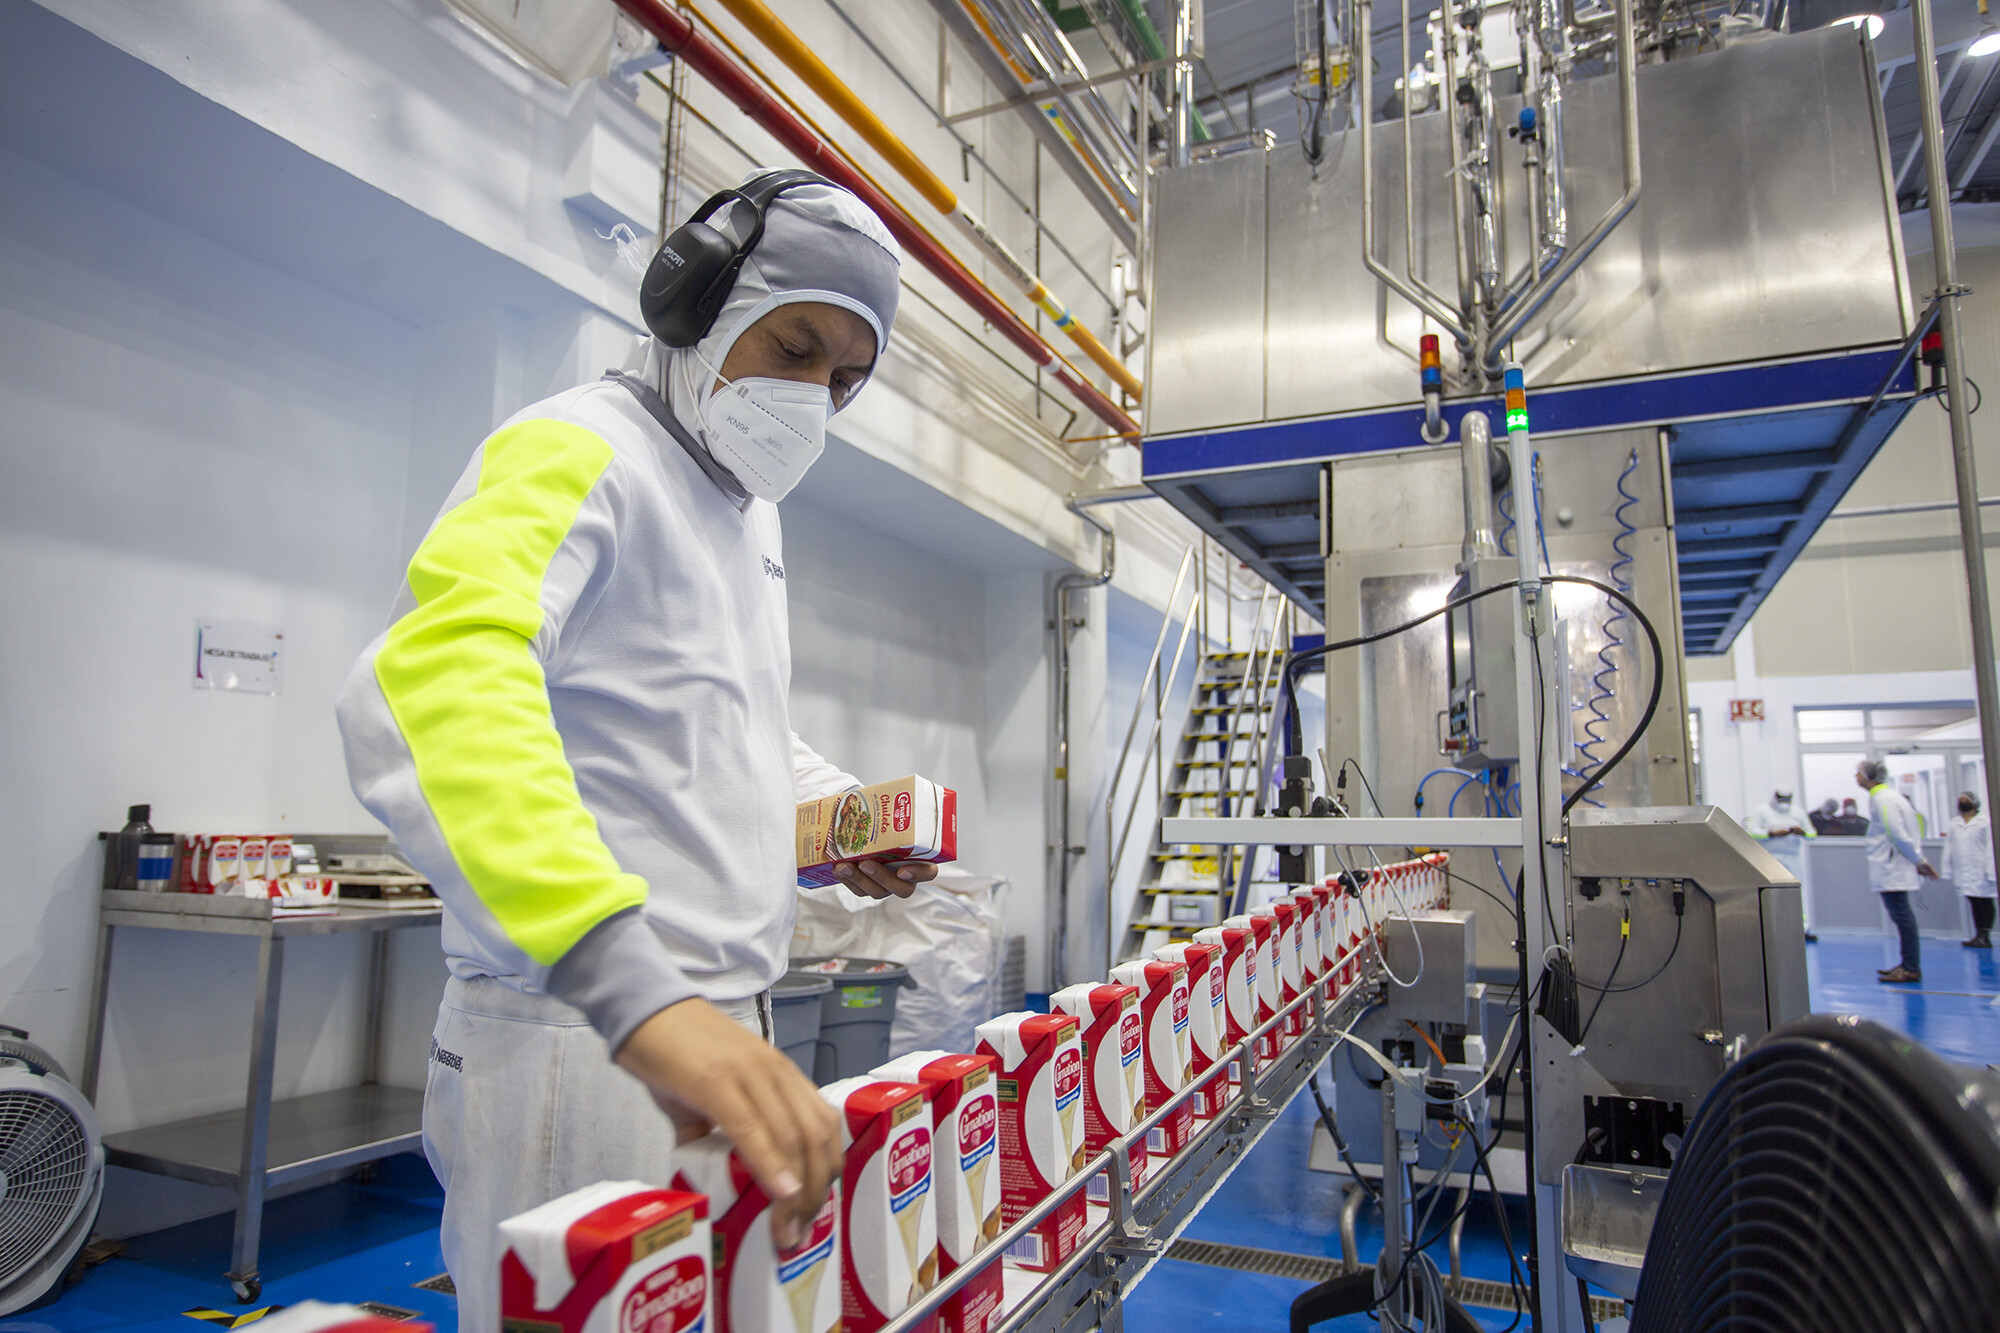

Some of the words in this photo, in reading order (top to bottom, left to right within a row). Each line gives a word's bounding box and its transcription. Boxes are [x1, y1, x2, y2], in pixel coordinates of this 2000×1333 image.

[726, 415, 750, 435] KN95
[880, 794, 890, 835] Chuleta
[897, 794, 909, 831] Carnation
[1055, 1060, 1081, 1089] Carnation
[961, 1108, 995, 1145] Carnation
[890, 1142, 930, 1184] Carnation
